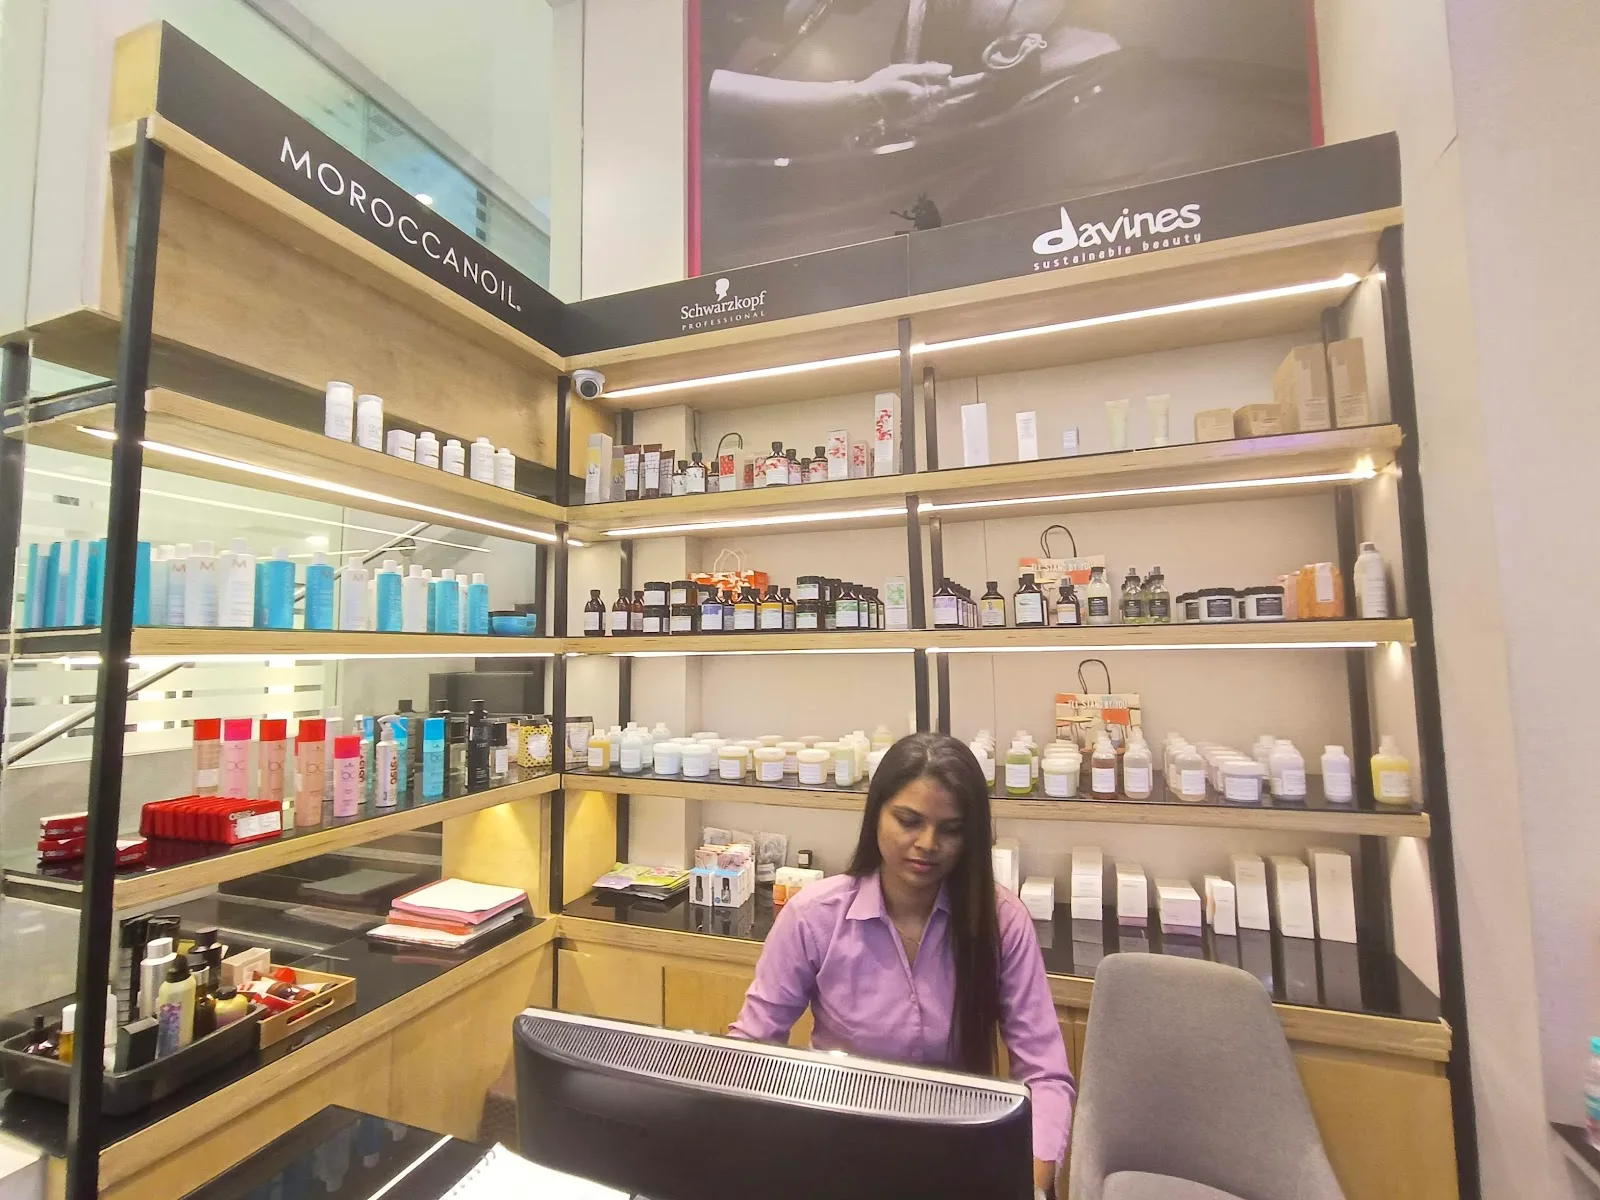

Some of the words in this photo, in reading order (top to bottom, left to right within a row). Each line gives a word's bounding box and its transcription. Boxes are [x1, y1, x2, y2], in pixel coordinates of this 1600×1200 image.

[1032, 203, 1201, 255] davines
[1033, 245, 1132, 271] sustainable
[1142, 232, 1202, 252] beauty
[680, 290, 767, 320] Schwarzkopf
[682, 310, 766, 331] PROFESSIONAL
